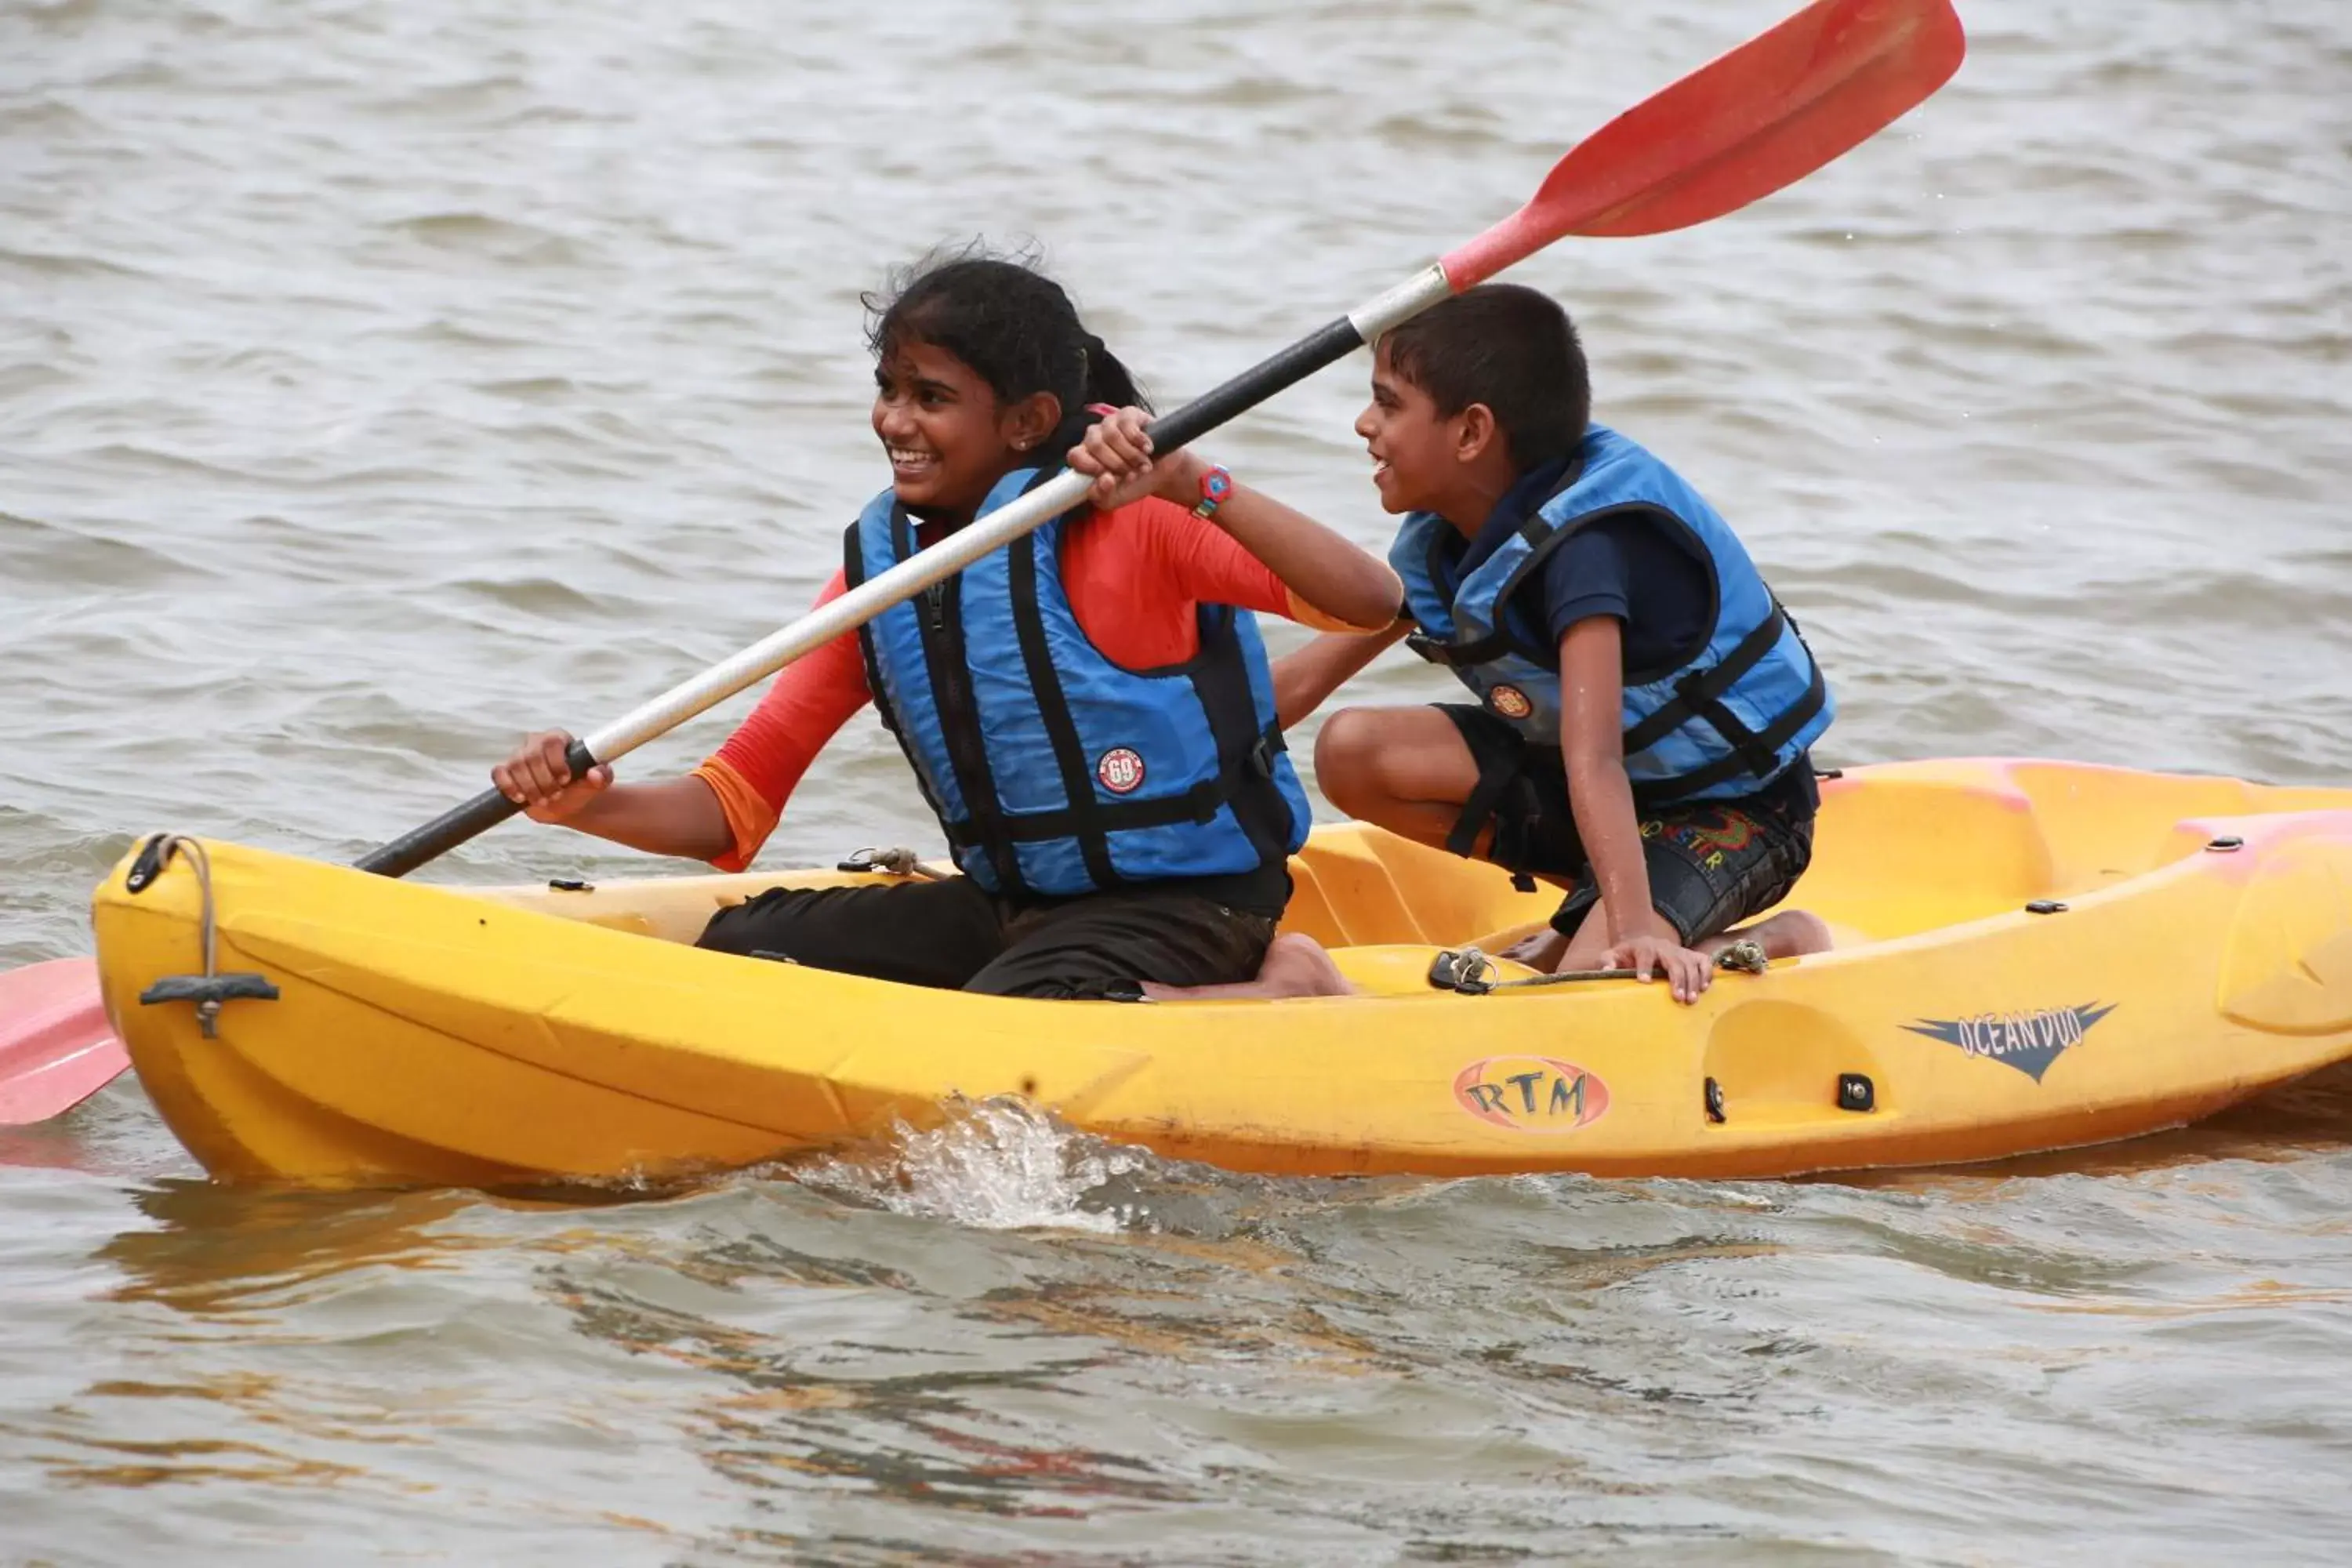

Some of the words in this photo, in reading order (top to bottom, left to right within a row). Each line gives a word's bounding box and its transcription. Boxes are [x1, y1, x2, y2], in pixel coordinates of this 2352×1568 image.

[1108, 758, 1134, 783] 69
[1958, 1013, 2039, 1058] OCEAN
[2038, 1006, 2083, 1047] DUO
[1465, 1071, 1585, 1116] RTM
